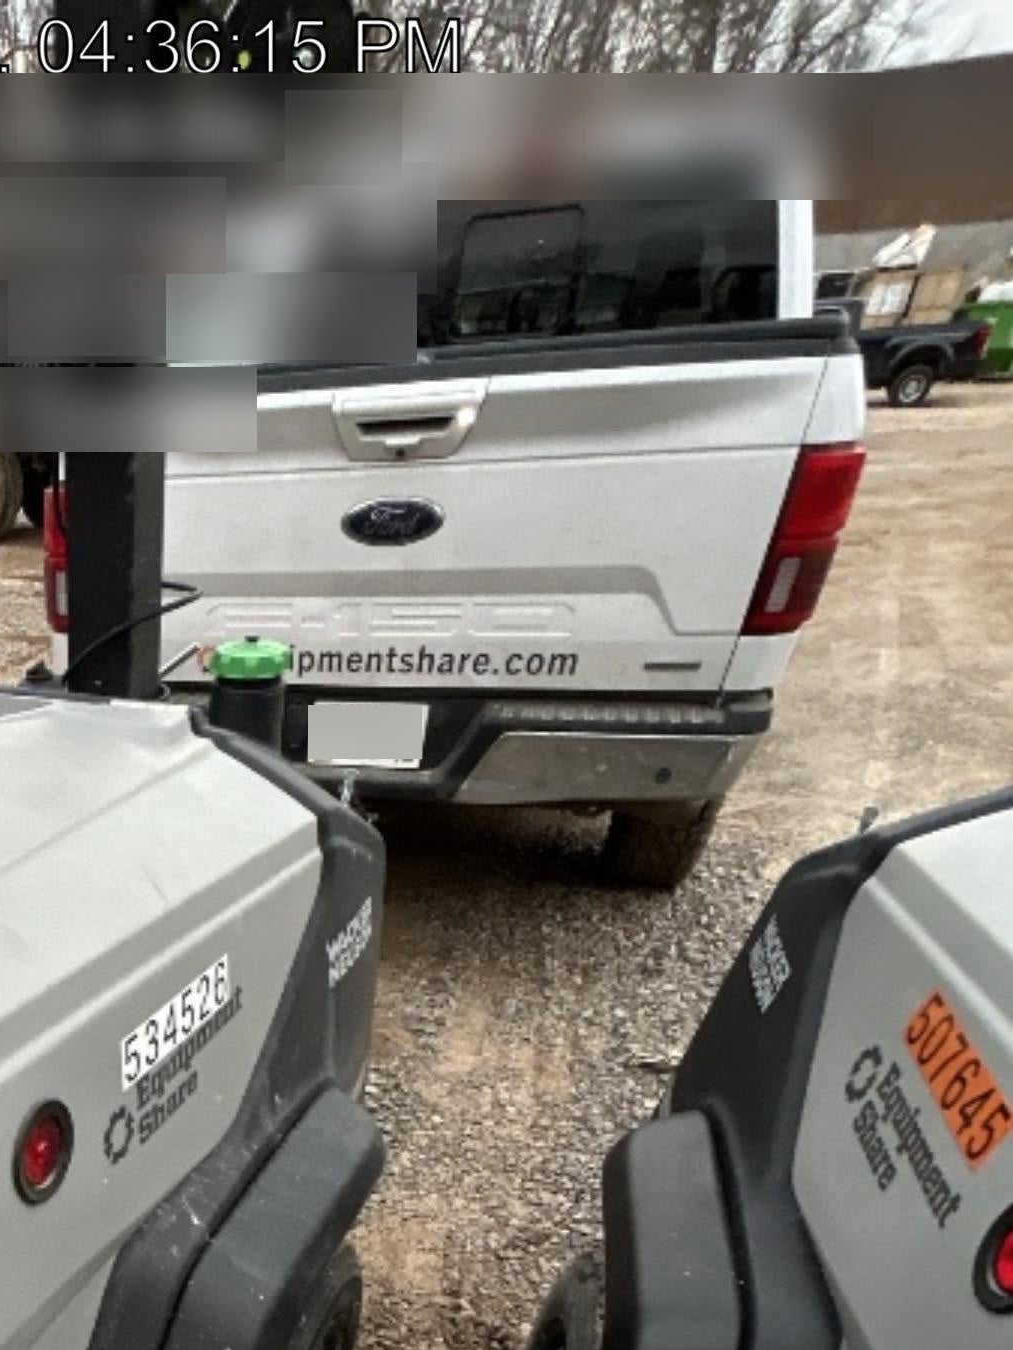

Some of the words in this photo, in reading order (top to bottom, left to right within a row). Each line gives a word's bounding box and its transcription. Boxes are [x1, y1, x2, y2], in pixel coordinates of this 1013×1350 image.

[288, 644, 580, 678] ipmentshare.com
[123, 961, 226, 1082] 534526
[139, 1069, 198, 1146] Share
[906, 992, 1012, 1161] 507645
[853, 1099, 897, 1192] Share
[875, 1060, 962, 1230] Equipment
